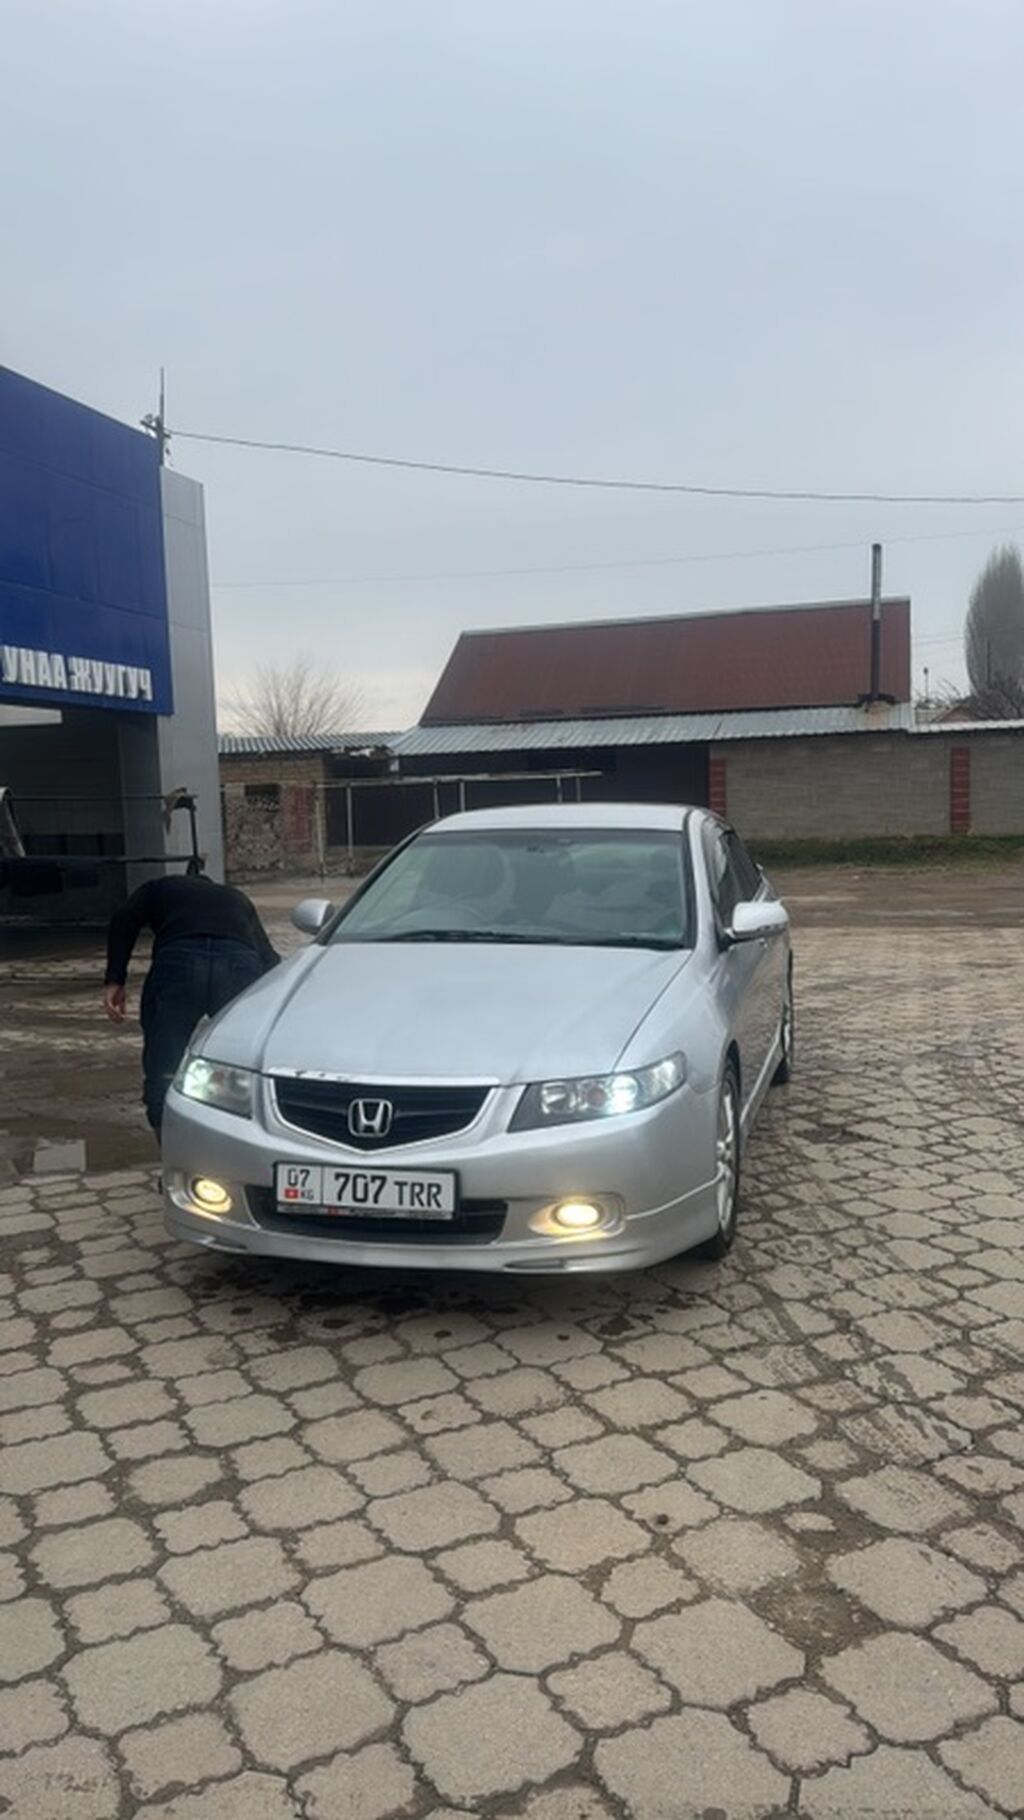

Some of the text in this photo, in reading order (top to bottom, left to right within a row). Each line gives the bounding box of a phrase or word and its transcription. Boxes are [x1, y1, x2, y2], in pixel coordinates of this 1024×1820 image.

[3, 645, 152, 701] УНАА ЖУУГУЧ
[288, 1168, 441, 1208] 07 707 TRR
